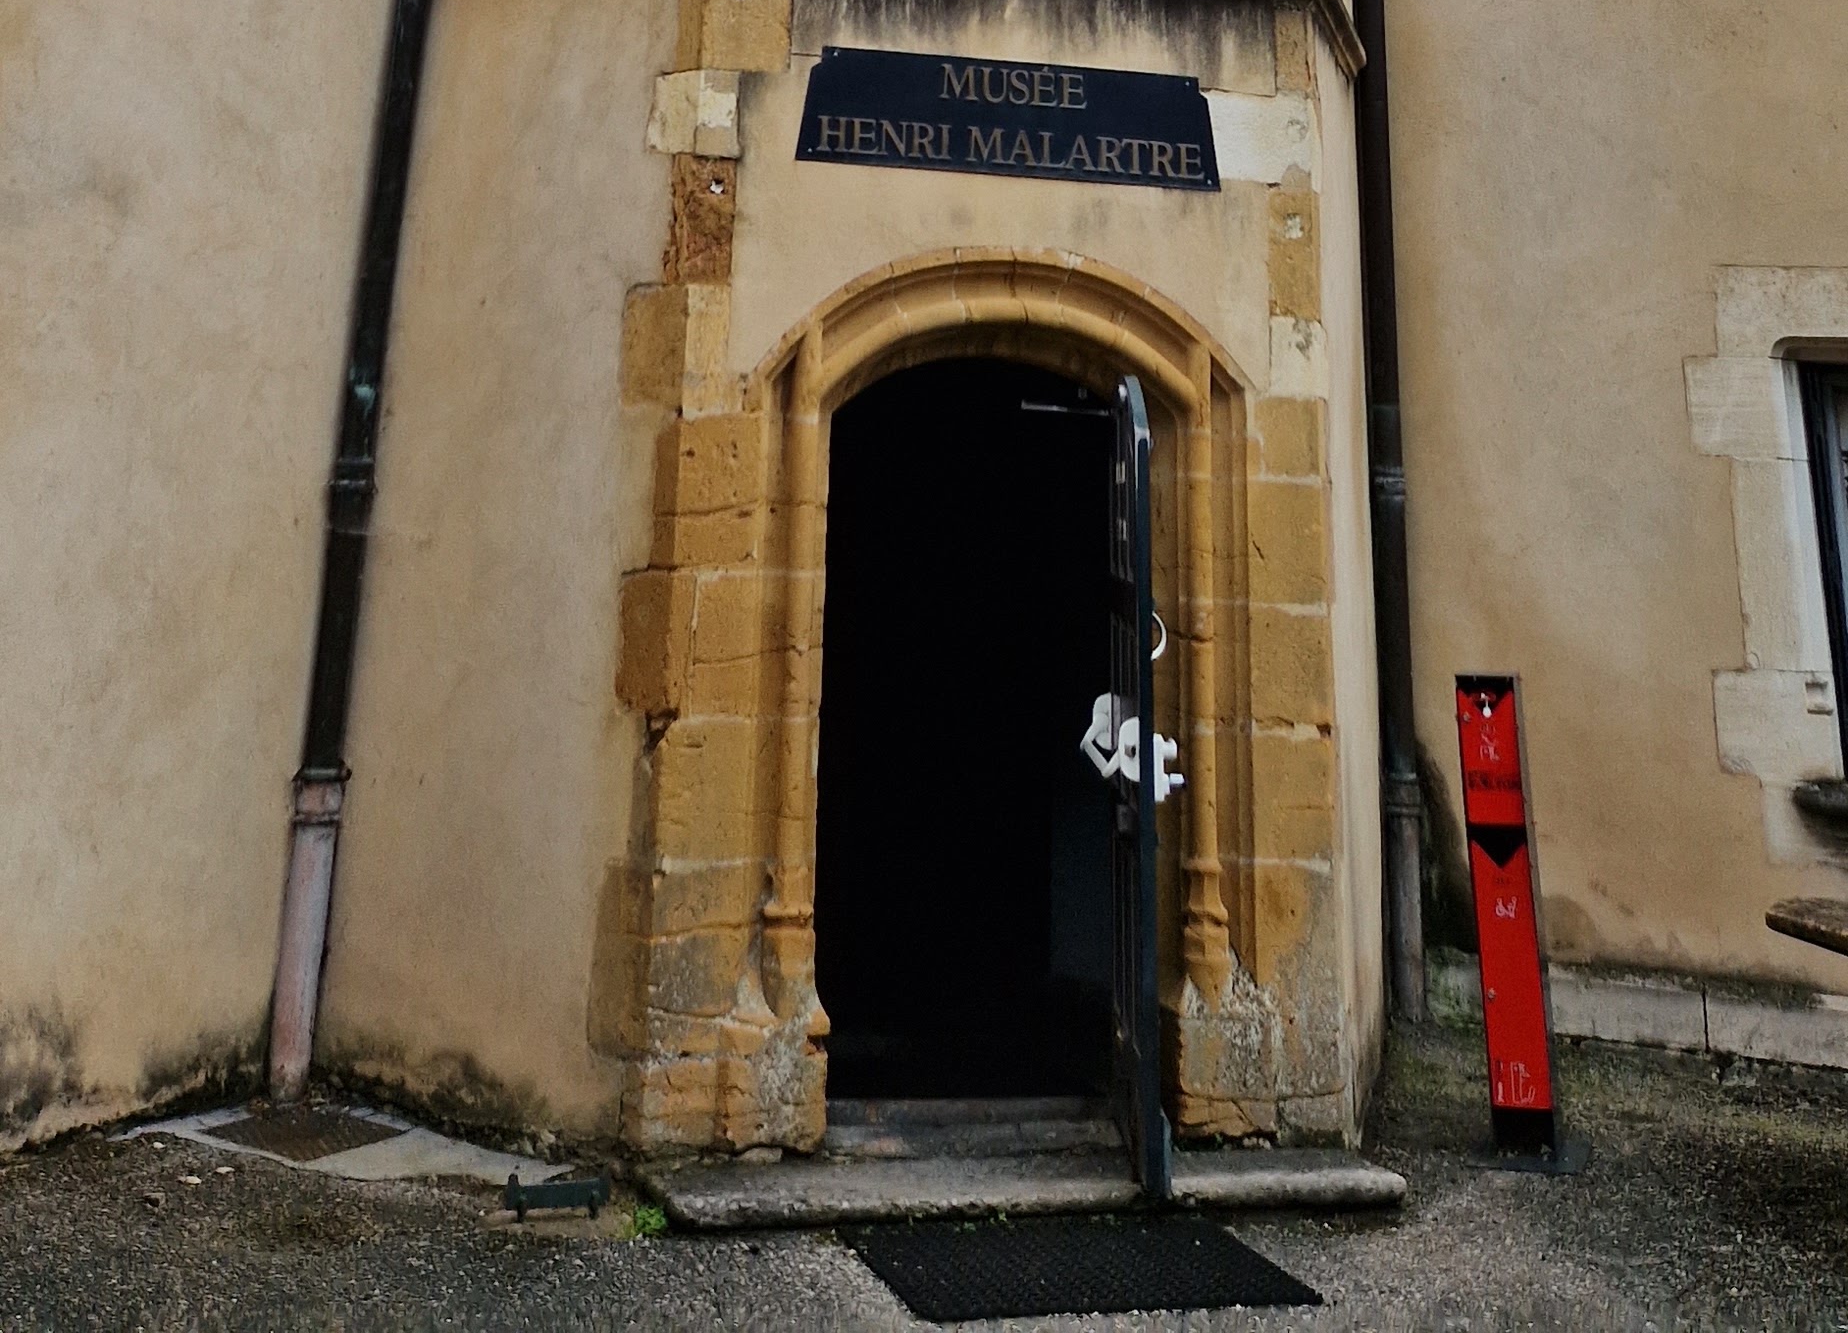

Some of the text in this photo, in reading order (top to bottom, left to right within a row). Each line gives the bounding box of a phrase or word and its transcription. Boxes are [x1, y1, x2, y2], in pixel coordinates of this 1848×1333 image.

[939, 63, 1087, 109] MUSÉE
[816, 115, 1205, 179] HENRI MALARTRE
